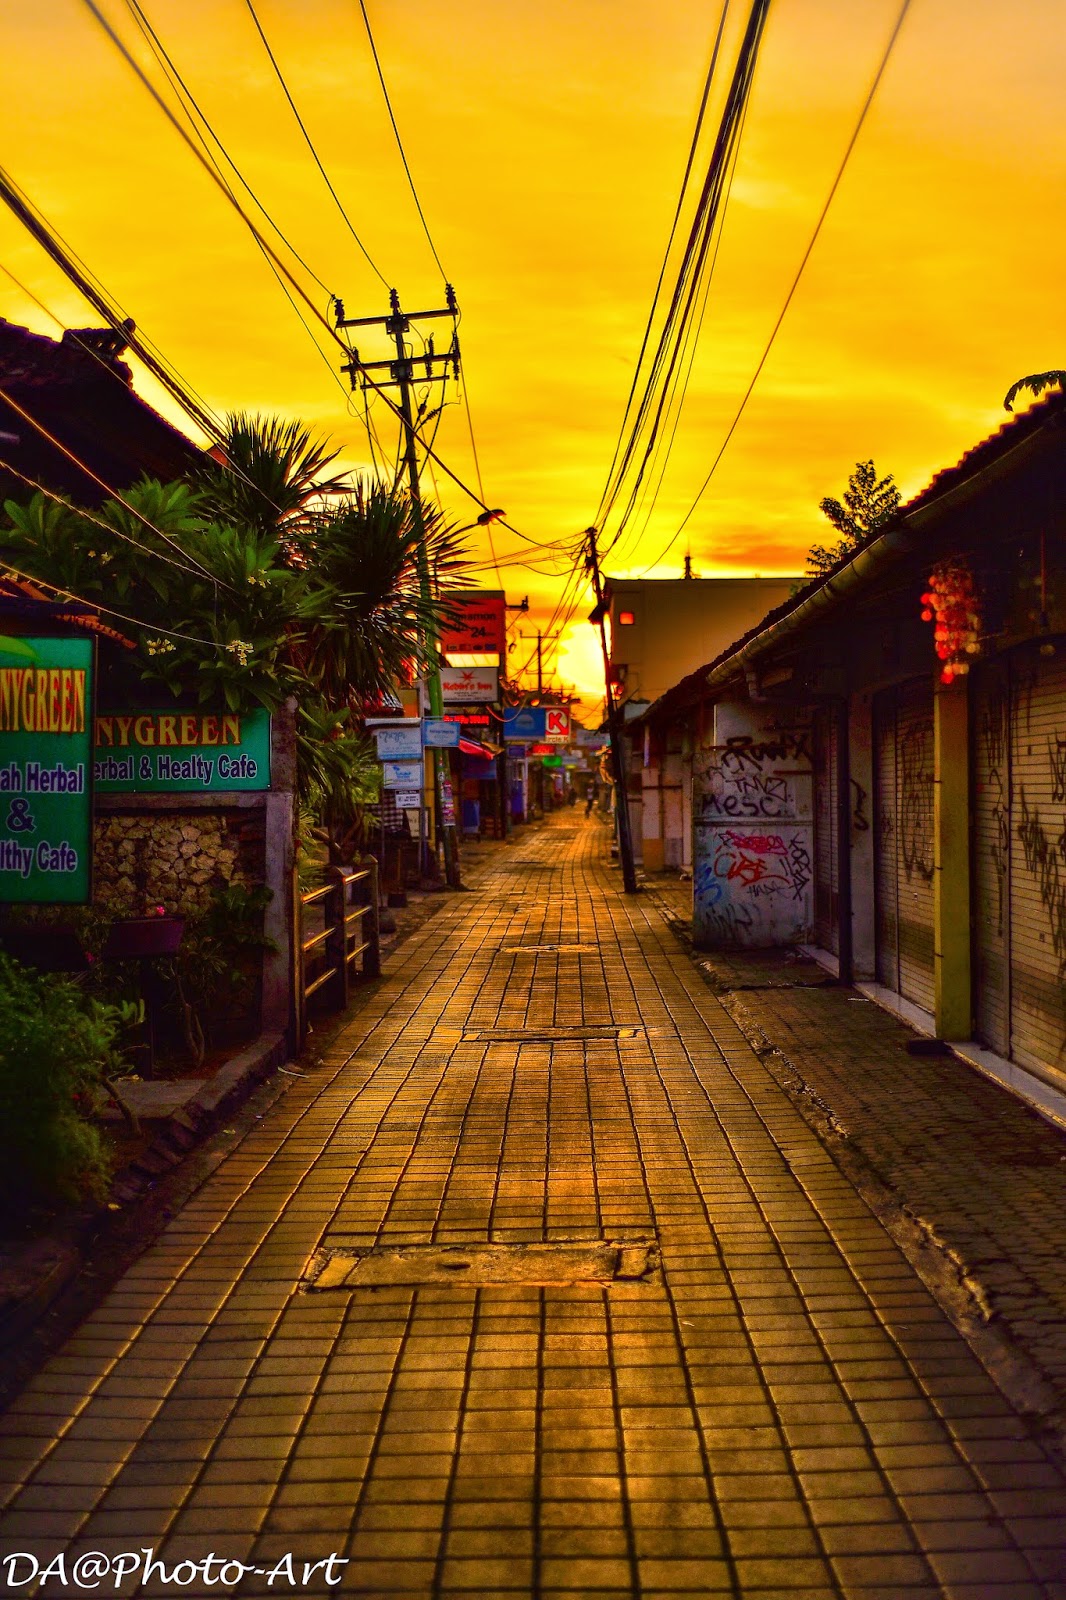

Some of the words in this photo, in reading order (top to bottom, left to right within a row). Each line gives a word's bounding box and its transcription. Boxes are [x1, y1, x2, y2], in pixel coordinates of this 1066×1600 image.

[471, 626, 486, 638] 24
[95, 715, 241, 746] NYGREEN
[548, 711, 569, 735] K
[25, 762, 84, 794] Herbal
[139, 755, 153, 780] &
[157, 754, 213, 785] Healty
[218, 753, 257, 780] Cafe
[6, 798, 37, 833] &
[37, 840, 78, 873] Cafe
